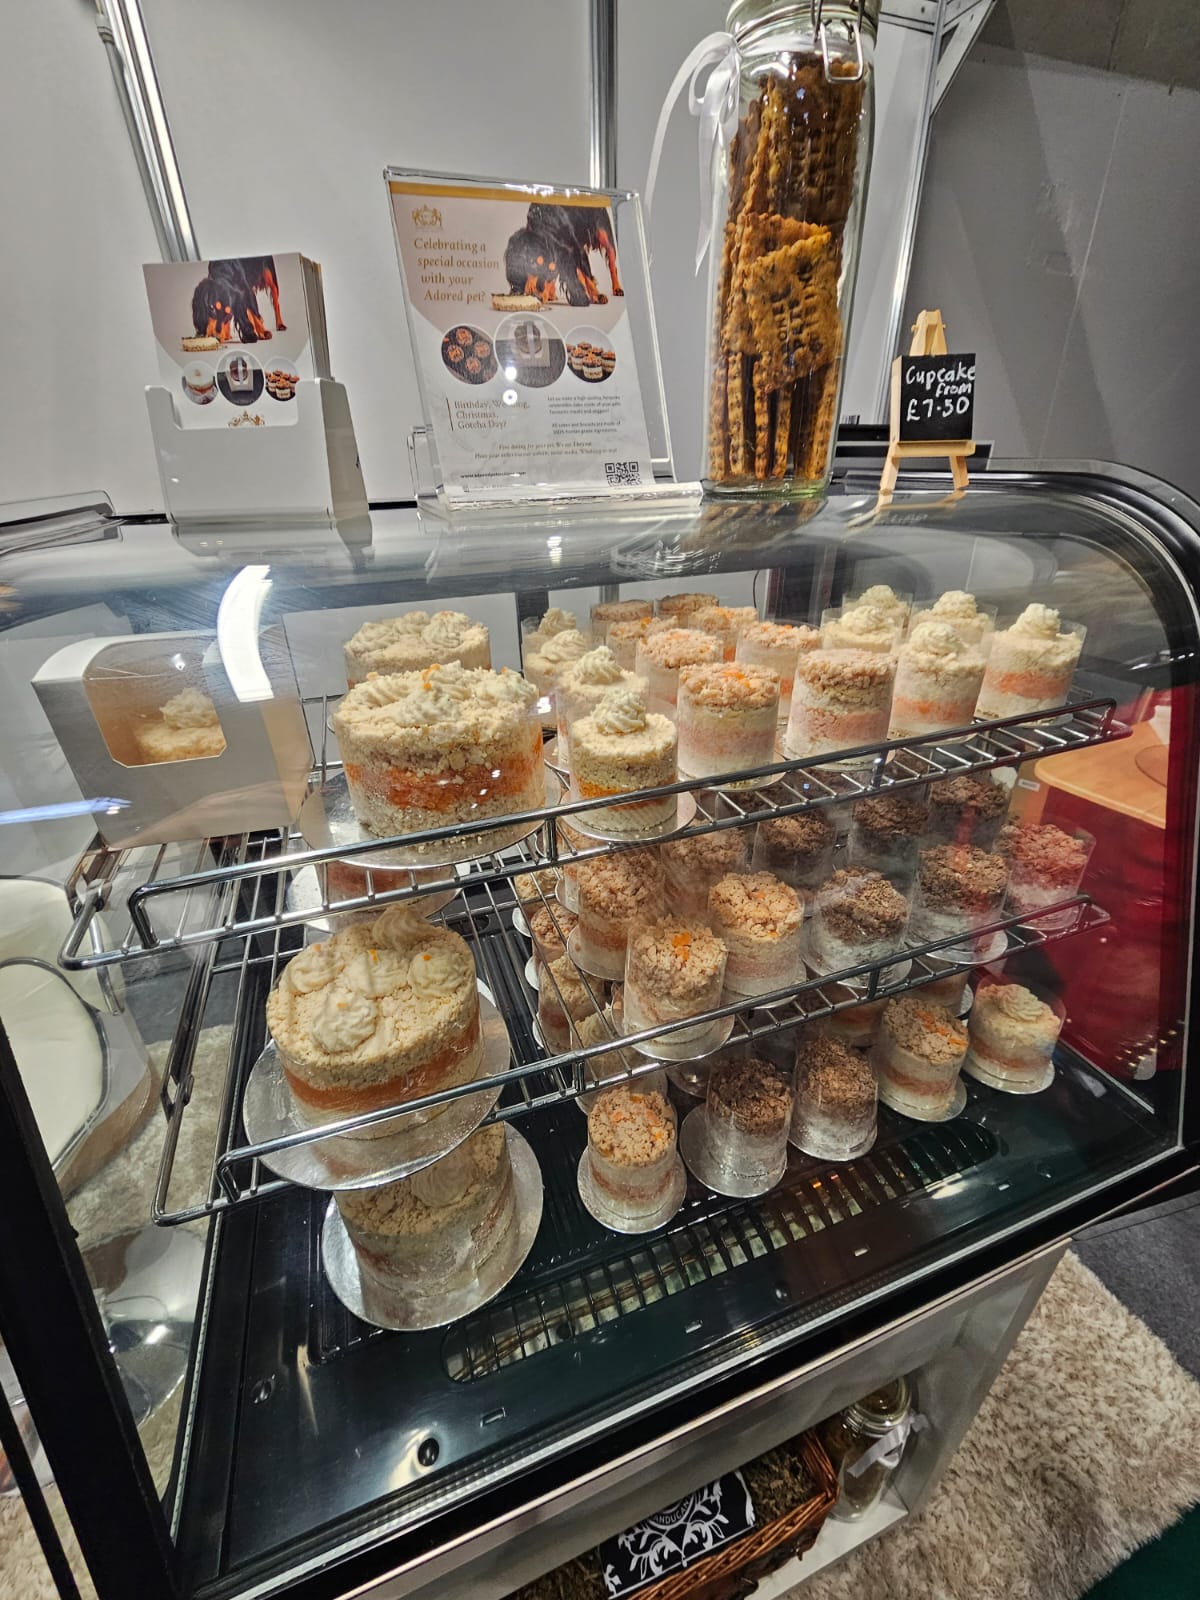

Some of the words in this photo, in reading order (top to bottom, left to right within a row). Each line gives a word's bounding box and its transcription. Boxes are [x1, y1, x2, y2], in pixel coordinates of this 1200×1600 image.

[413, 237, 478, 255] Celebrating
[480, 243, 486, 252] a
[417, 255, 454, 269] special
[456, 257, 500, 270] occasion
[421, 272, 445, 284] with
[448, 276, 474, 287] your
[424, 288, 464, 302] Adored
[466, 290, 486, 305] pet?
[906, 361, 976, 391] Cupcake
[935, 382, 972, 398] from
[454, 400, 491, 409] Birthday,
